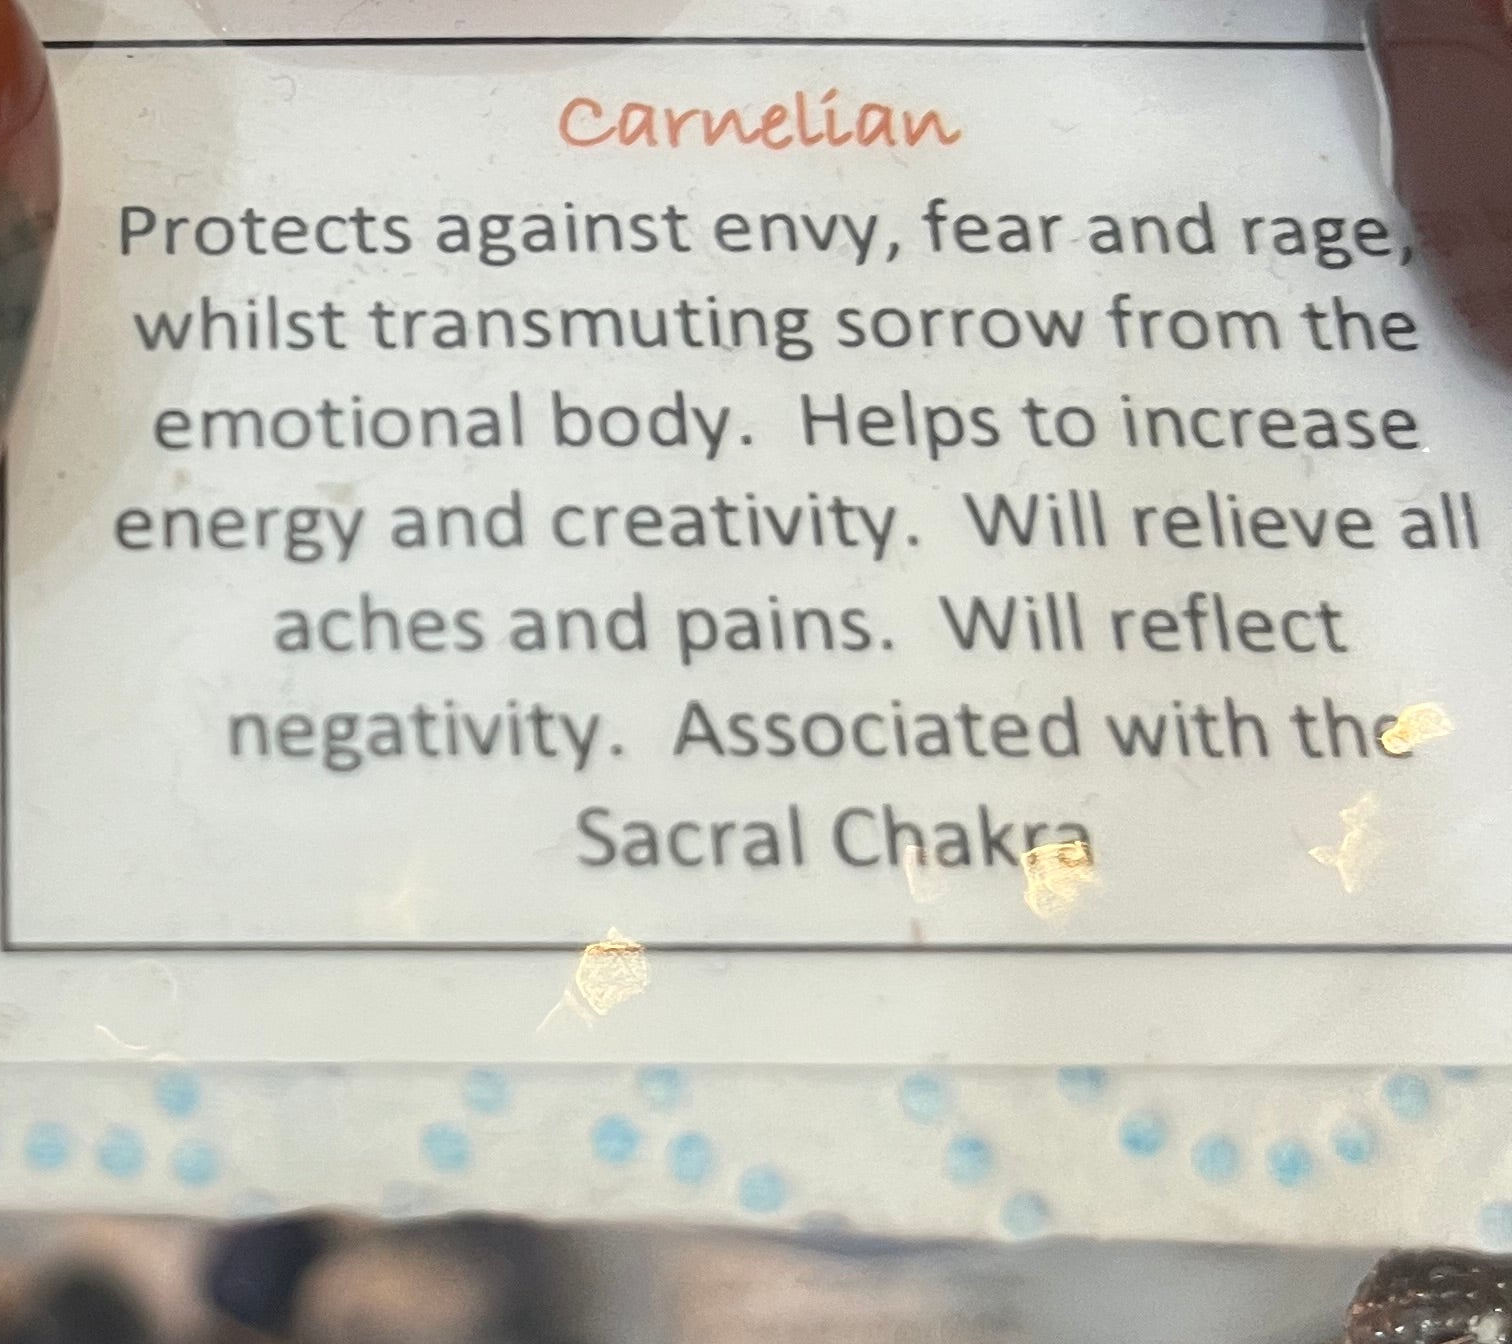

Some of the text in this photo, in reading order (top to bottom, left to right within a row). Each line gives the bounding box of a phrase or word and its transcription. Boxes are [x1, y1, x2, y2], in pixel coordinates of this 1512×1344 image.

[559, 89, 961, 150] Carnelian
[120, 197, 1414, 270] Protects against envy, fear and rage,
[133, 293, 1418, 362] whilst transmuting sorrow from the
[153, 389, 1420, 461] emotional body. Helps to increase
[114, 489, 1480, 564] energy and creativity. Will relieve all
[274, 592, 1349, 667] aches and pains. Will reflect
[229, 696, 1415, 774] negativity. Associated with the
[577, 804, 804, 869] Sacral
